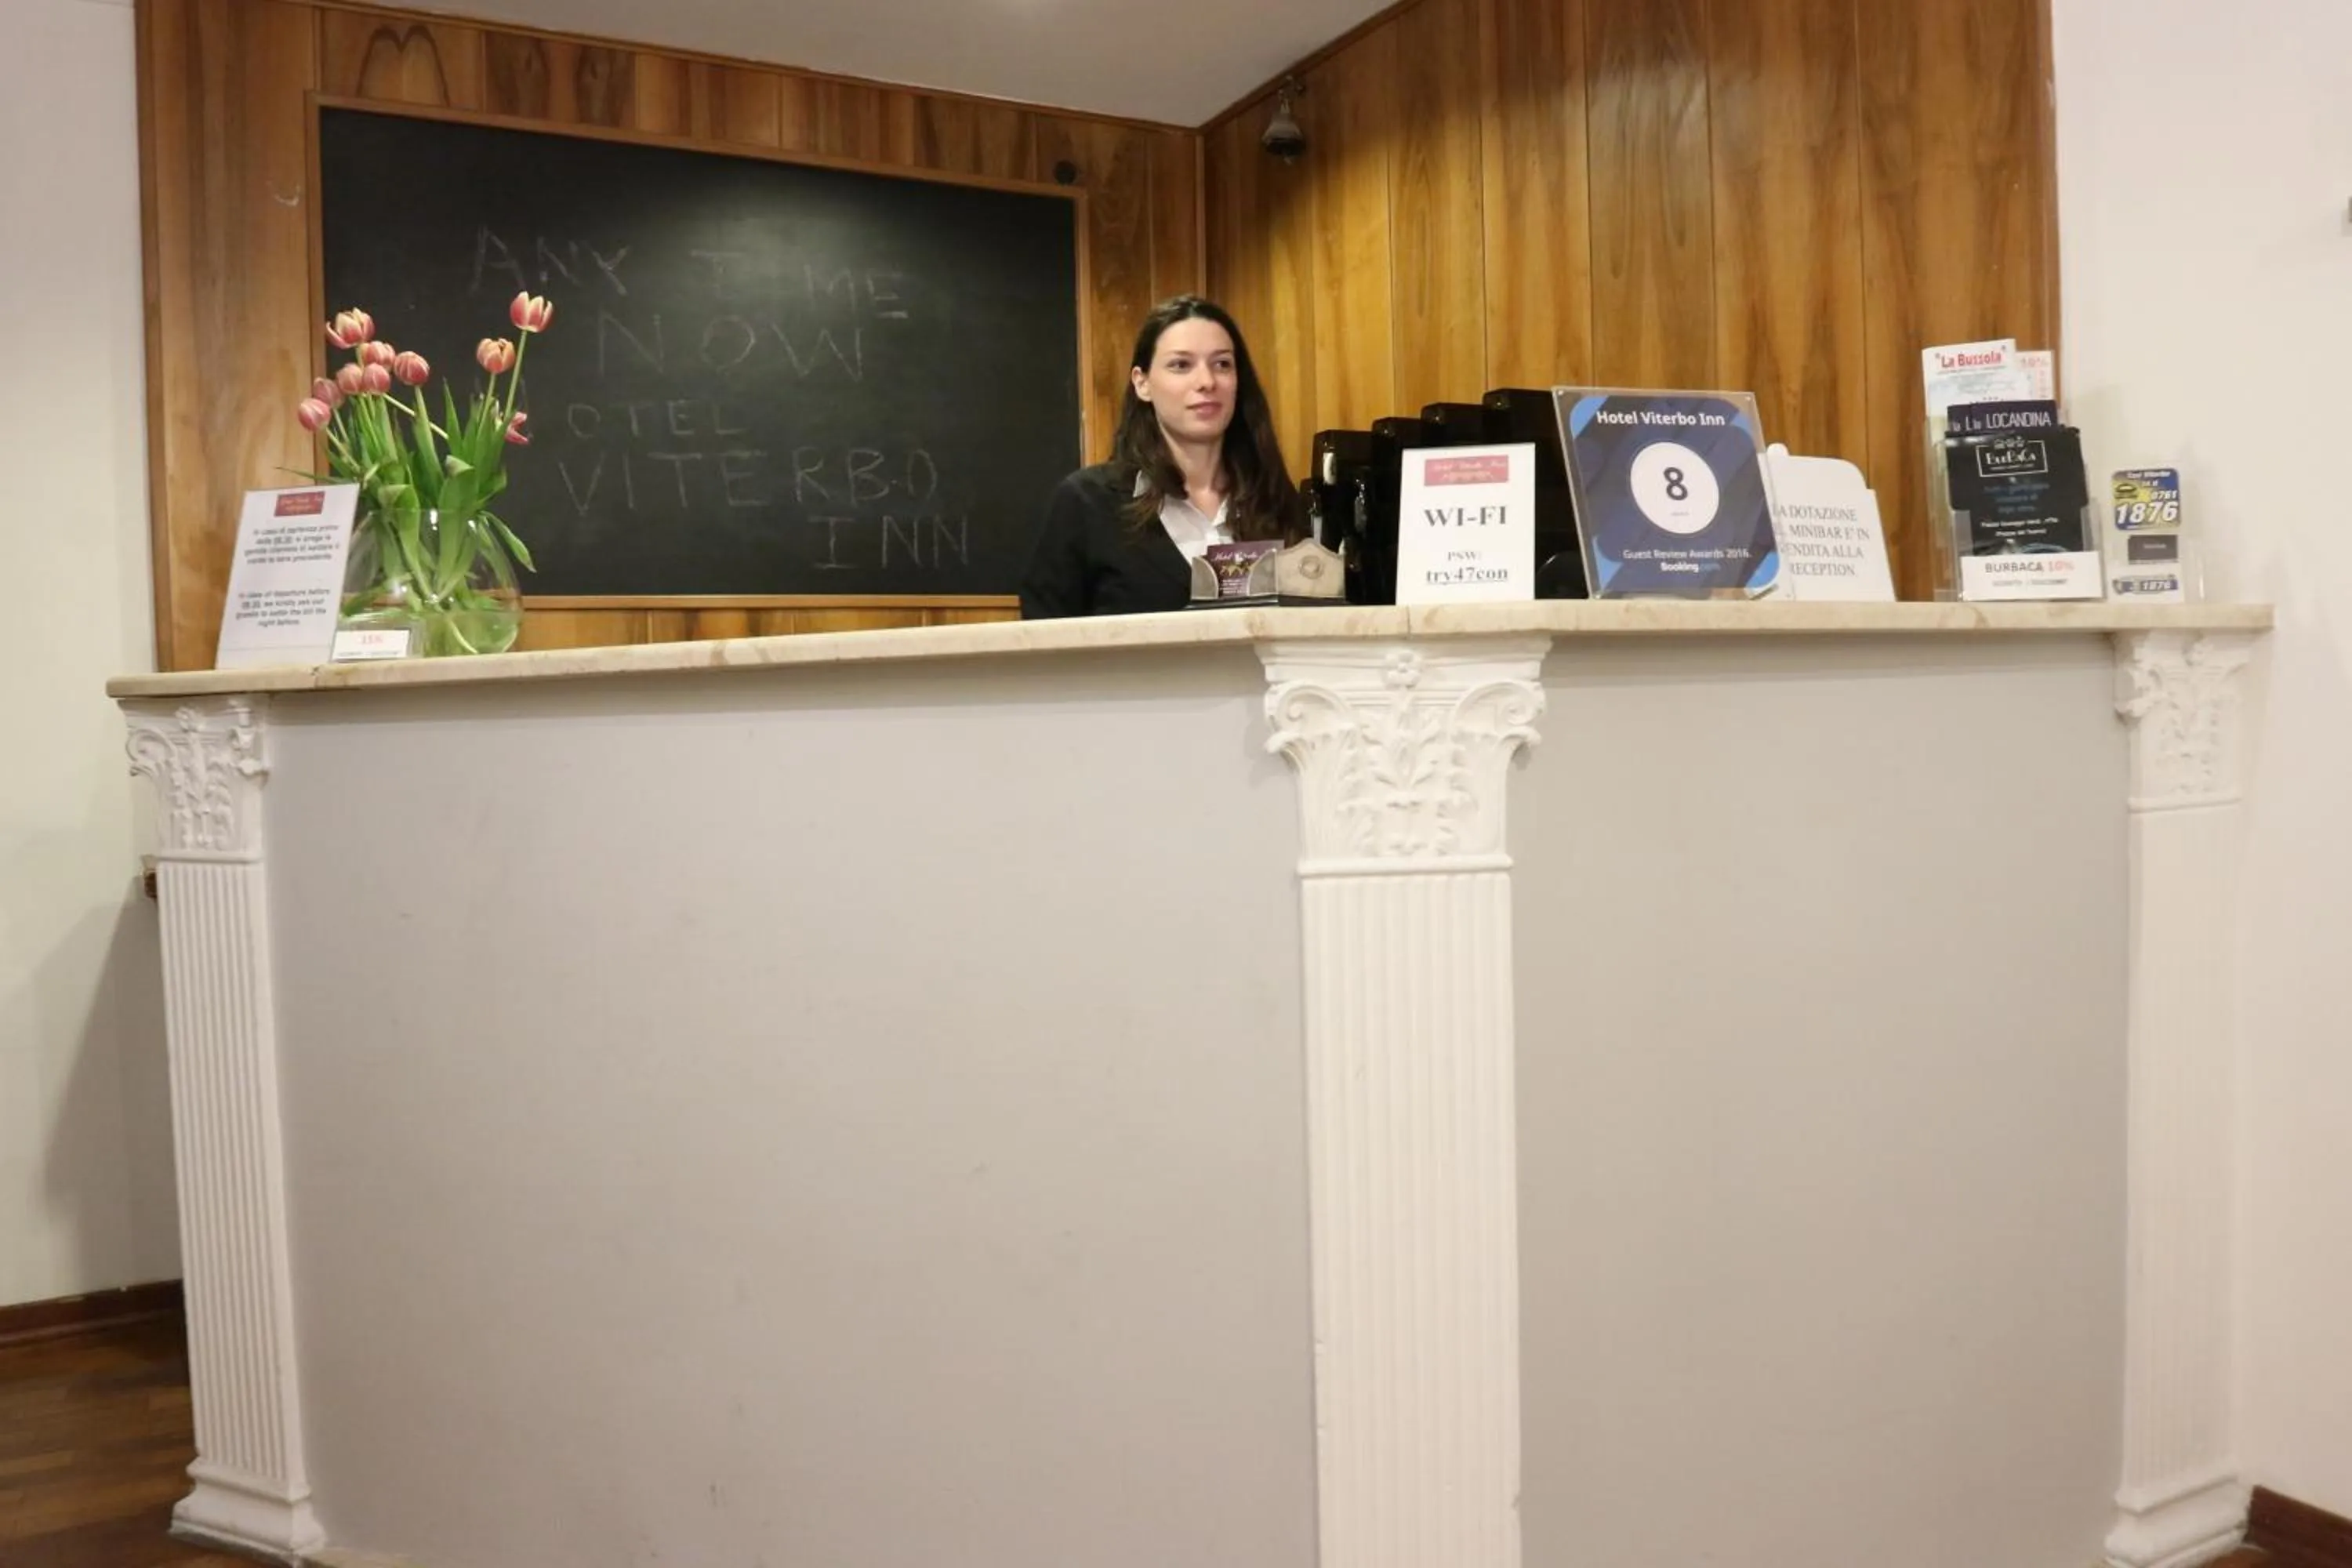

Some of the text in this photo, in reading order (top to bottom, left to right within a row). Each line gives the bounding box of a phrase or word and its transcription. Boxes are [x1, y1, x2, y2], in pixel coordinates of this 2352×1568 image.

[467, 224, 910, 318] ANY TME
[596, 309, 864, 383] NOW
[1596, 411, 1725, 426] Hotel Viterbo Inn
[1986, 412, 2053, 428] LOCANDINA
[557, 445, 939, 517] VITERBO
[1663, 466, 1688, 501] 8
[2151, 490, 2177, 500] 0761
[1425, 506, 1507, 528] WI-FI
[1788, 505, 1857, 521] DOTAZIONE
[2117, 501, 2178, 524] 1876
[1789, 524, 1842, 539] MINIBAR
[1857, 528, 1870, 540] IN
[807, 512, 969, 570] INN
[1623, 550, 1652, 559] Guest
[1653, 550, 1687, 559] Review
[1690, 550, 1724, 559] Awards
[1832, 545, 1864, 558] ALLA
[1425, 567, 1509, 585] try47con
[1985, 561, 2045, 574] BURBACA
